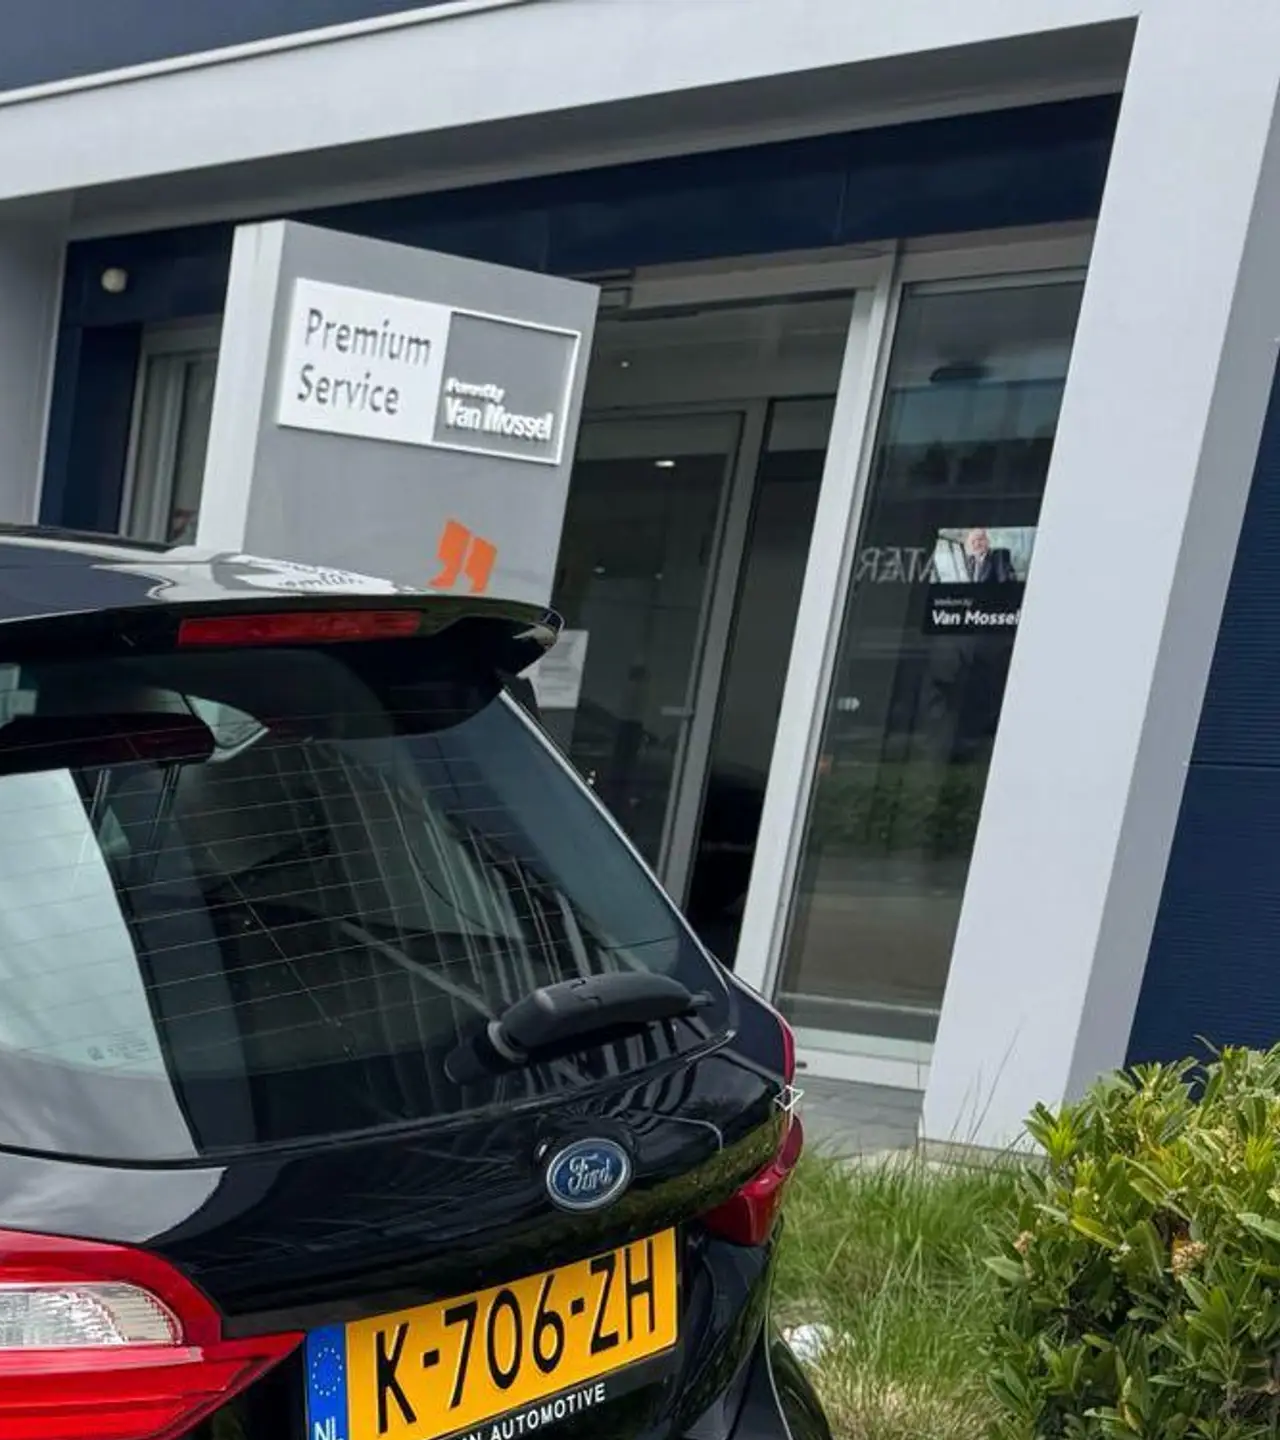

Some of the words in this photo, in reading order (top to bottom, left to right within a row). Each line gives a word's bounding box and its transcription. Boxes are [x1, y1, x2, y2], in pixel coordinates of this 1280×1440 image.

[304, 307, 432, 366] Premium
[297, 363, 400, 415] Service
[446, 397, 482, 429] Van
[483, 402, 554, 440] Mossel
[932, 610, 960, 625] Van
[568, 1153, 613, 1196] Ford
[374, 1239, 655, 1435] K-706-ZH
